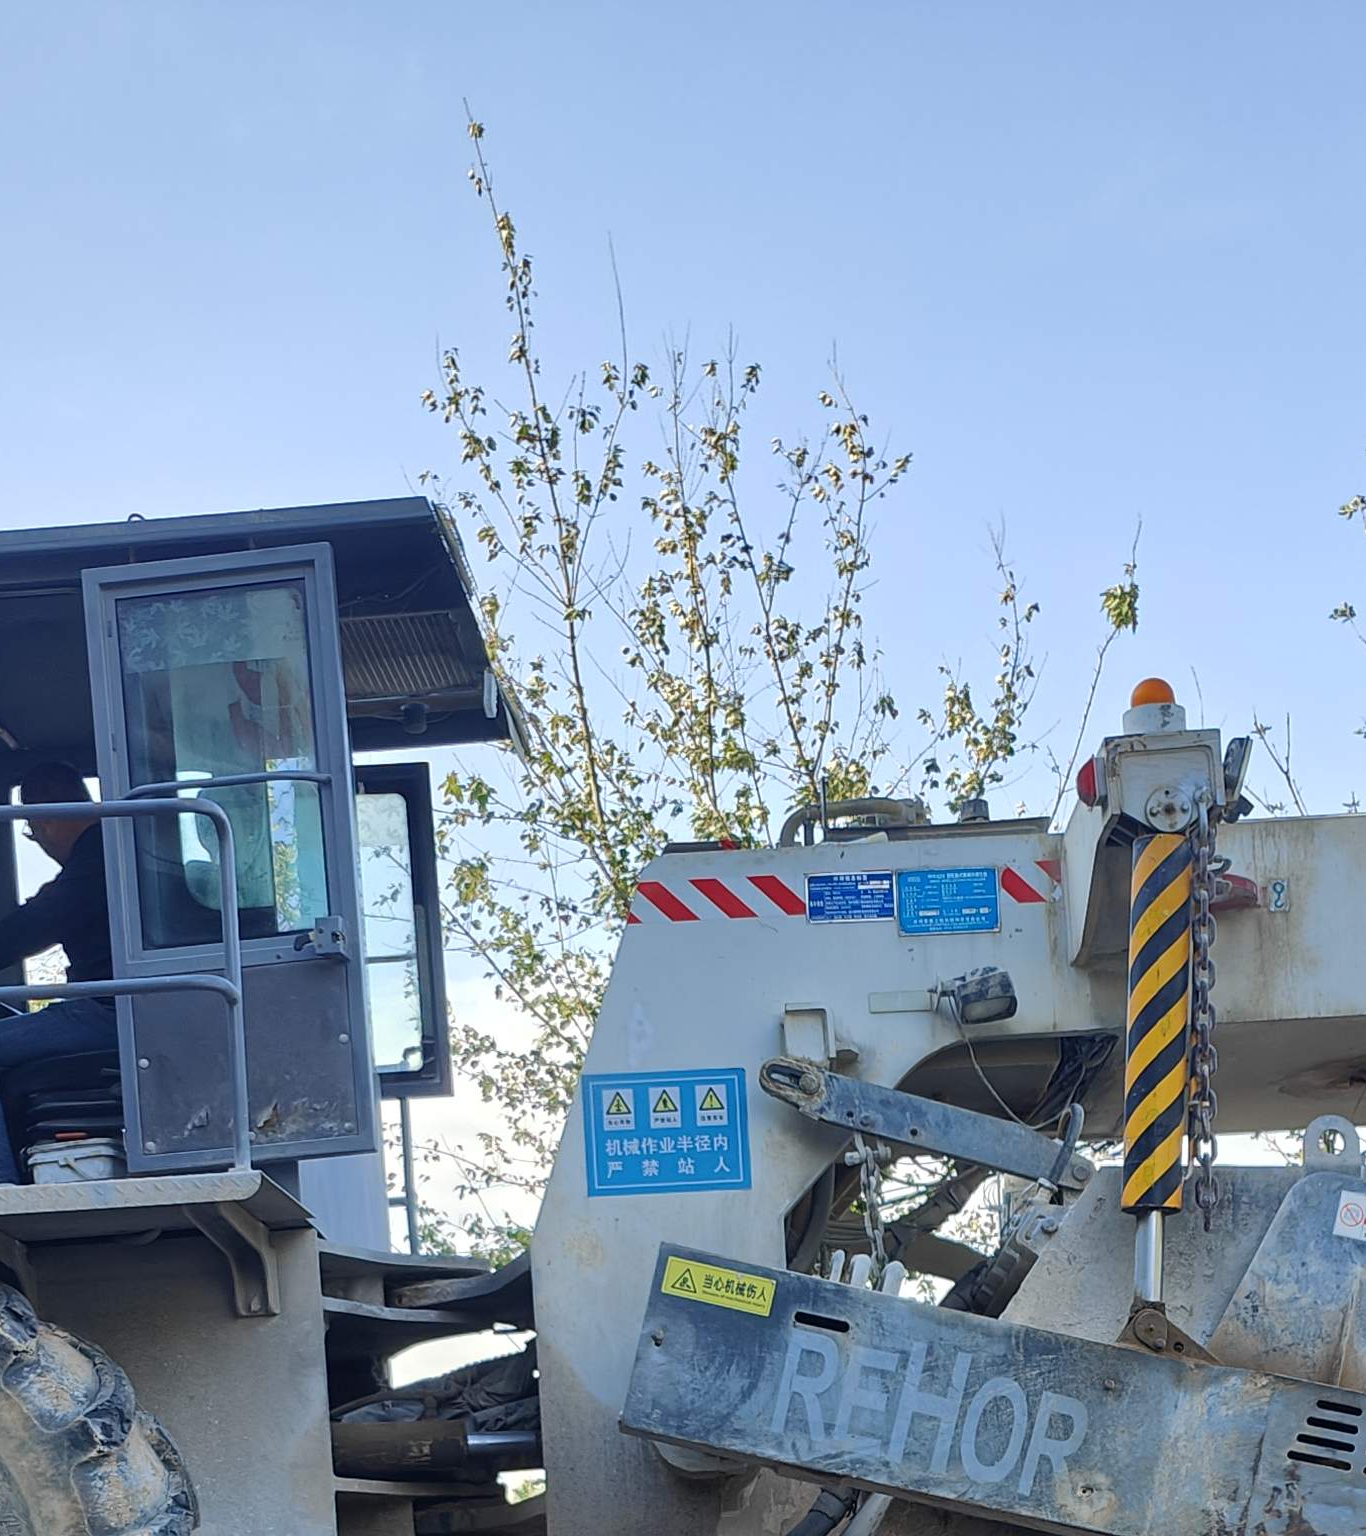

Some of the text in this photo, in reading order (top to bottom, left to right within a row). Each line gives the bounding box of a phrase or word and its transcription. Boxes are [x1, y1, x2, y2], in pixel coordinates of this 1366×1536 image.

[605, 1133, 729, 1157] 机械作业半径内
[606, 1156, 731, 1179] 严禁站人
[702, 1273, 767, 1302] 当心机械伤人
[770, 1328, 1086, 1497] REHOR
